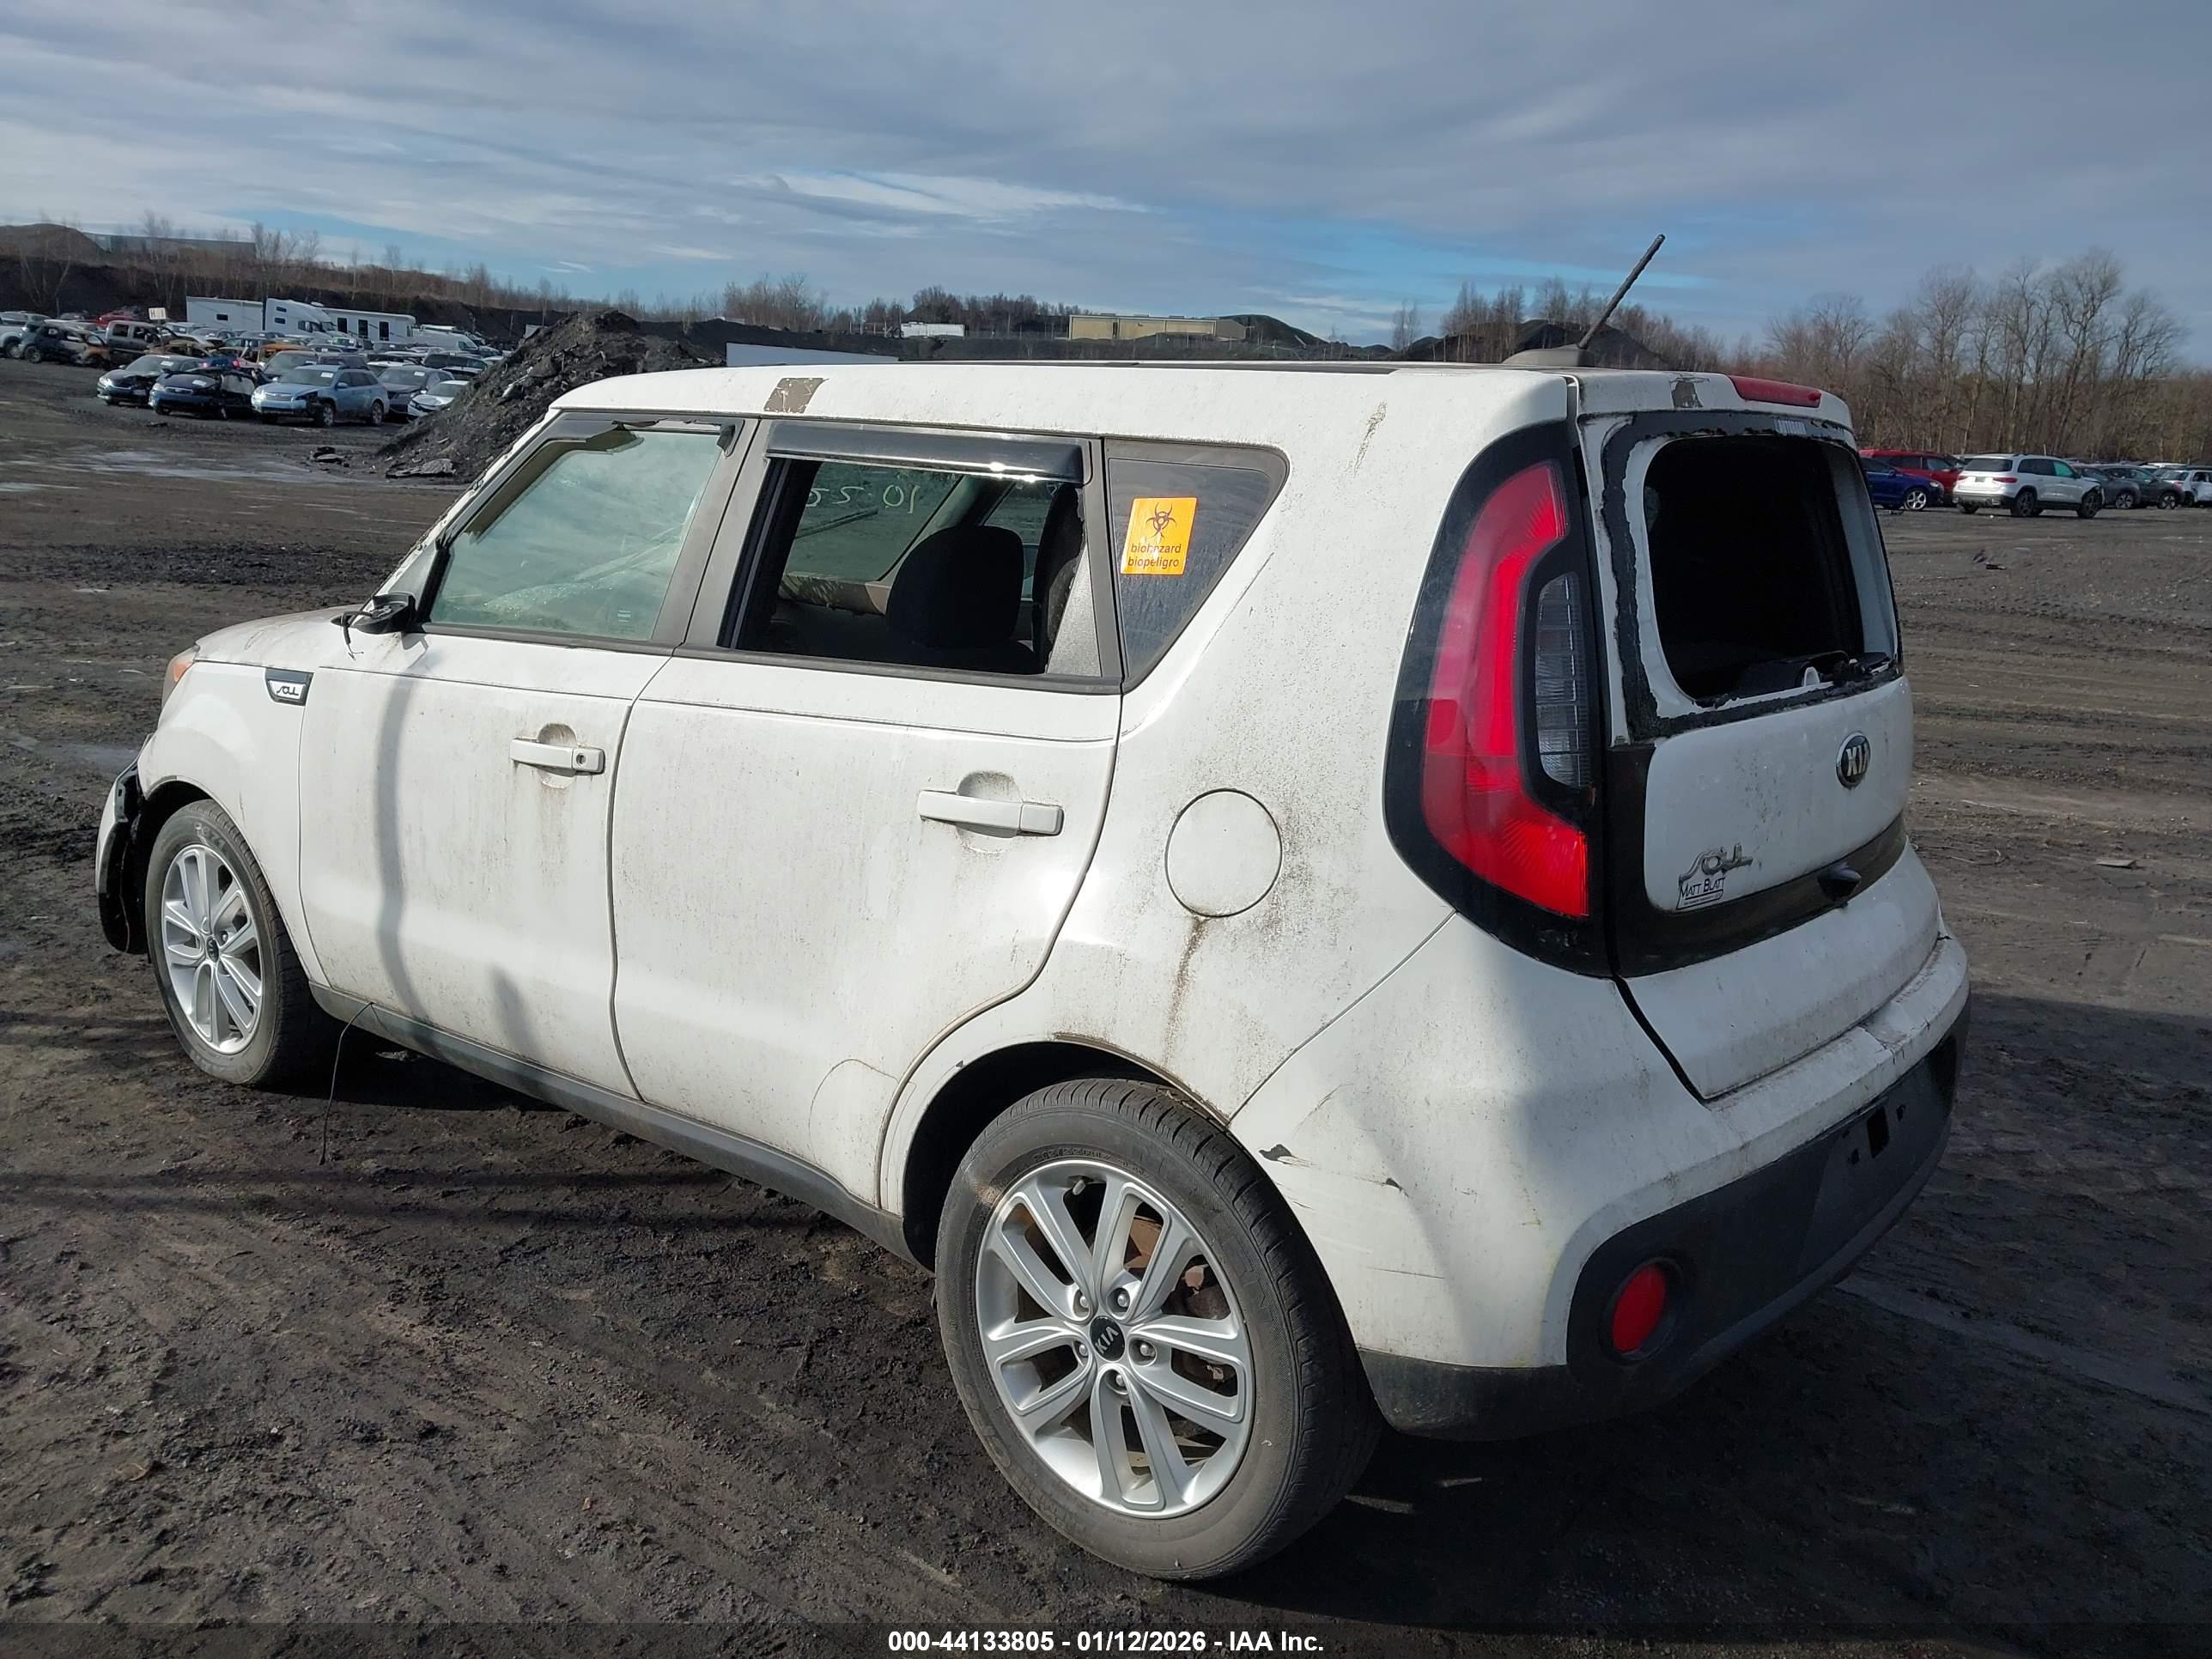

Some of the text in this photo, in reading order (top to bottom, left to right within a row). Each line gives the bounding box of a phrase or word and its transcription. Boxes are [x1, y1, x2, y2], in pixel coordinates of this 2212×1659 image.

[1130, 543, 1182, 554] biohazard
[1127, 556, 1180, 570] biopeligro
[1845, 743, 1869, 777] KIA
[1680, 877, 1726, 898] MATT BLATT
[1094, 1326, 1119, 1354] KIA
